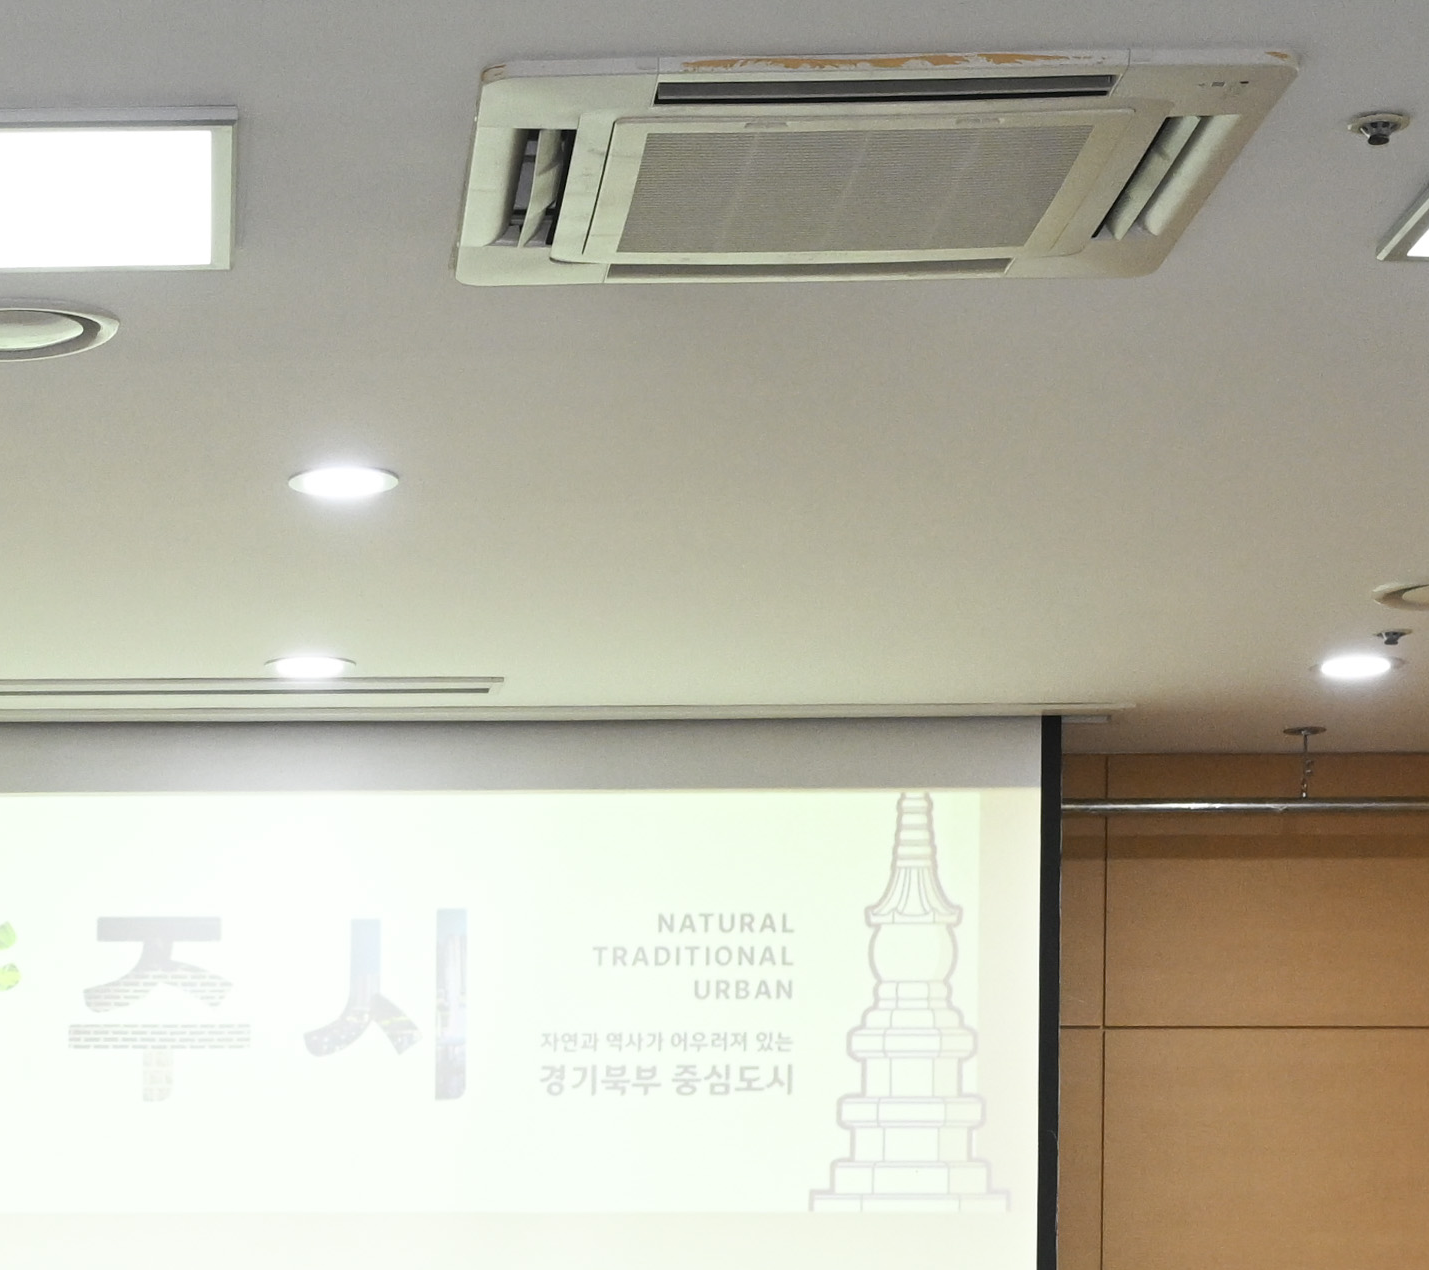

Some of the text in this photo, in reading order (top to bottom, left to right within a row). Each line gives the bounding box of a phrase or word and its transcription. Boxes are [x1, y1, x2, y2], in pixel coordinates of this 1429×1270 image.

[657, 912, 796, 934] NATURAL
[592, 945, 796, 967] TRADITIONAL
[693, 979, 795, 1000] URBAN
[541, 1032, 599, 1052] 자연과
[606, 1032, 663, 1052] 역사가
[755, 1032, 794, 1052] 있는
[540, 1064, 794, 1096] 경기북부 중심도시
